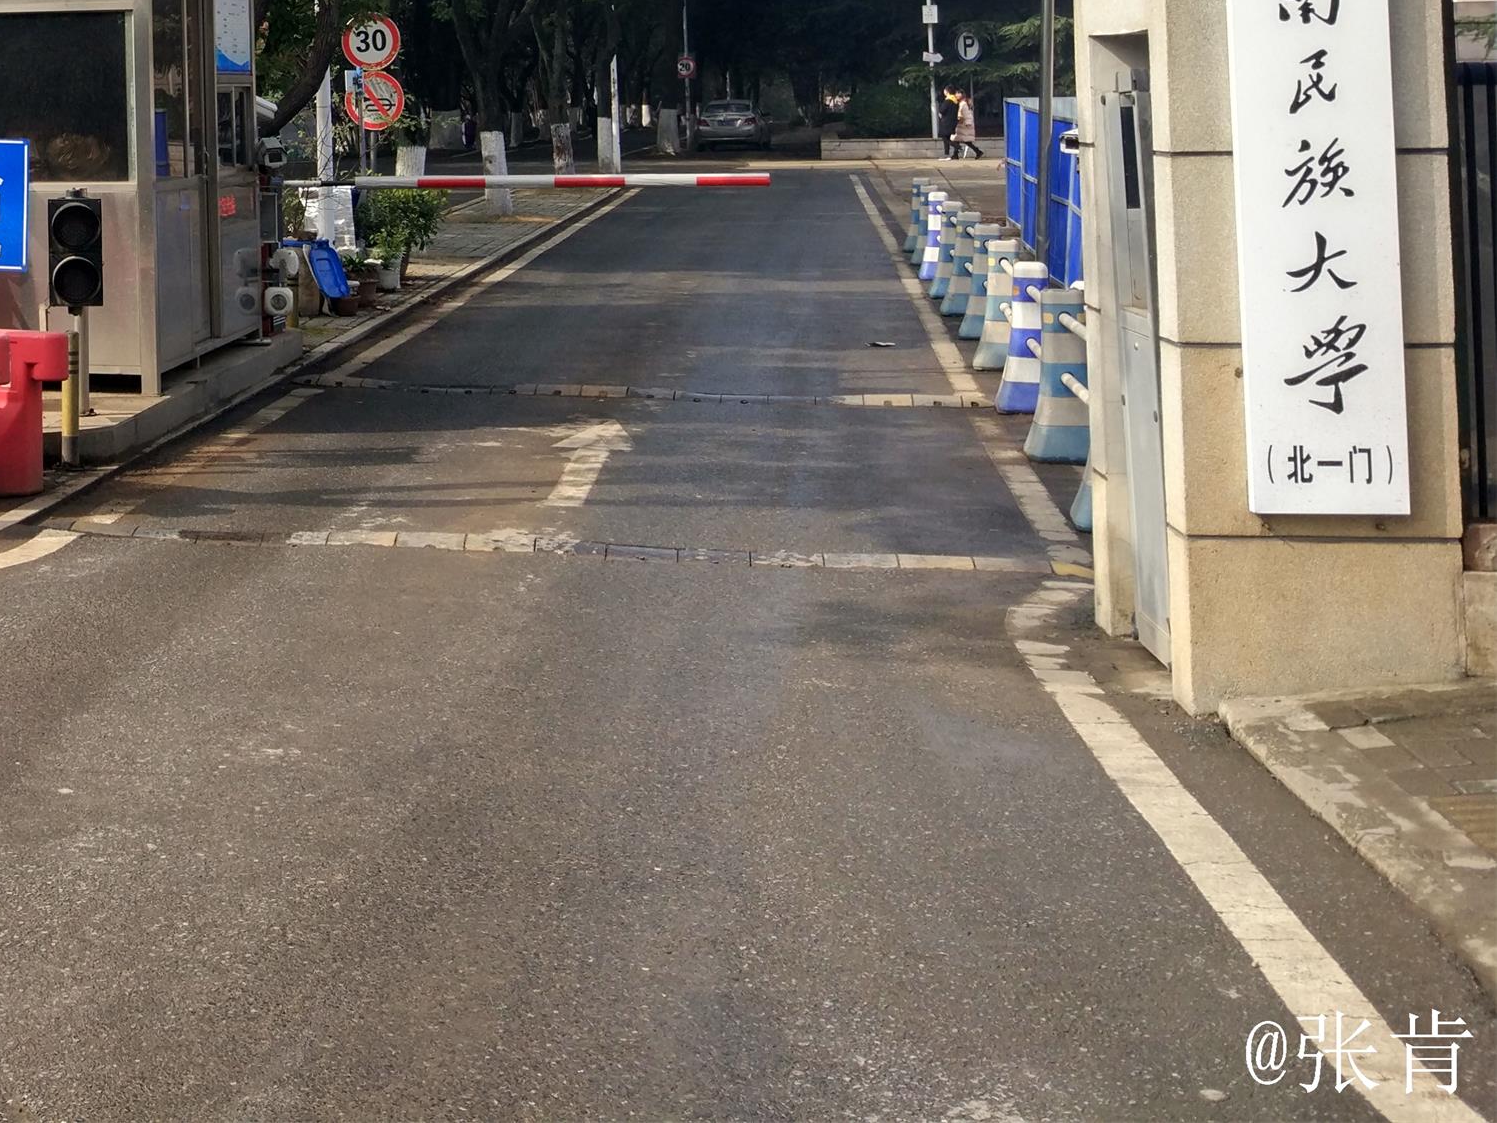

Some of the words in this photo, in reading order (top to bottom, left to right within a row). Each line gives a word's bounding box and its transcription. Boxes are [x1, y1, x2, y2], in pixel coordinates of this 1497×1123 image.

[356, 29, 387, 53] 30
[963, 36, 975, 58] P
[679, 63, 690, 72] 20
